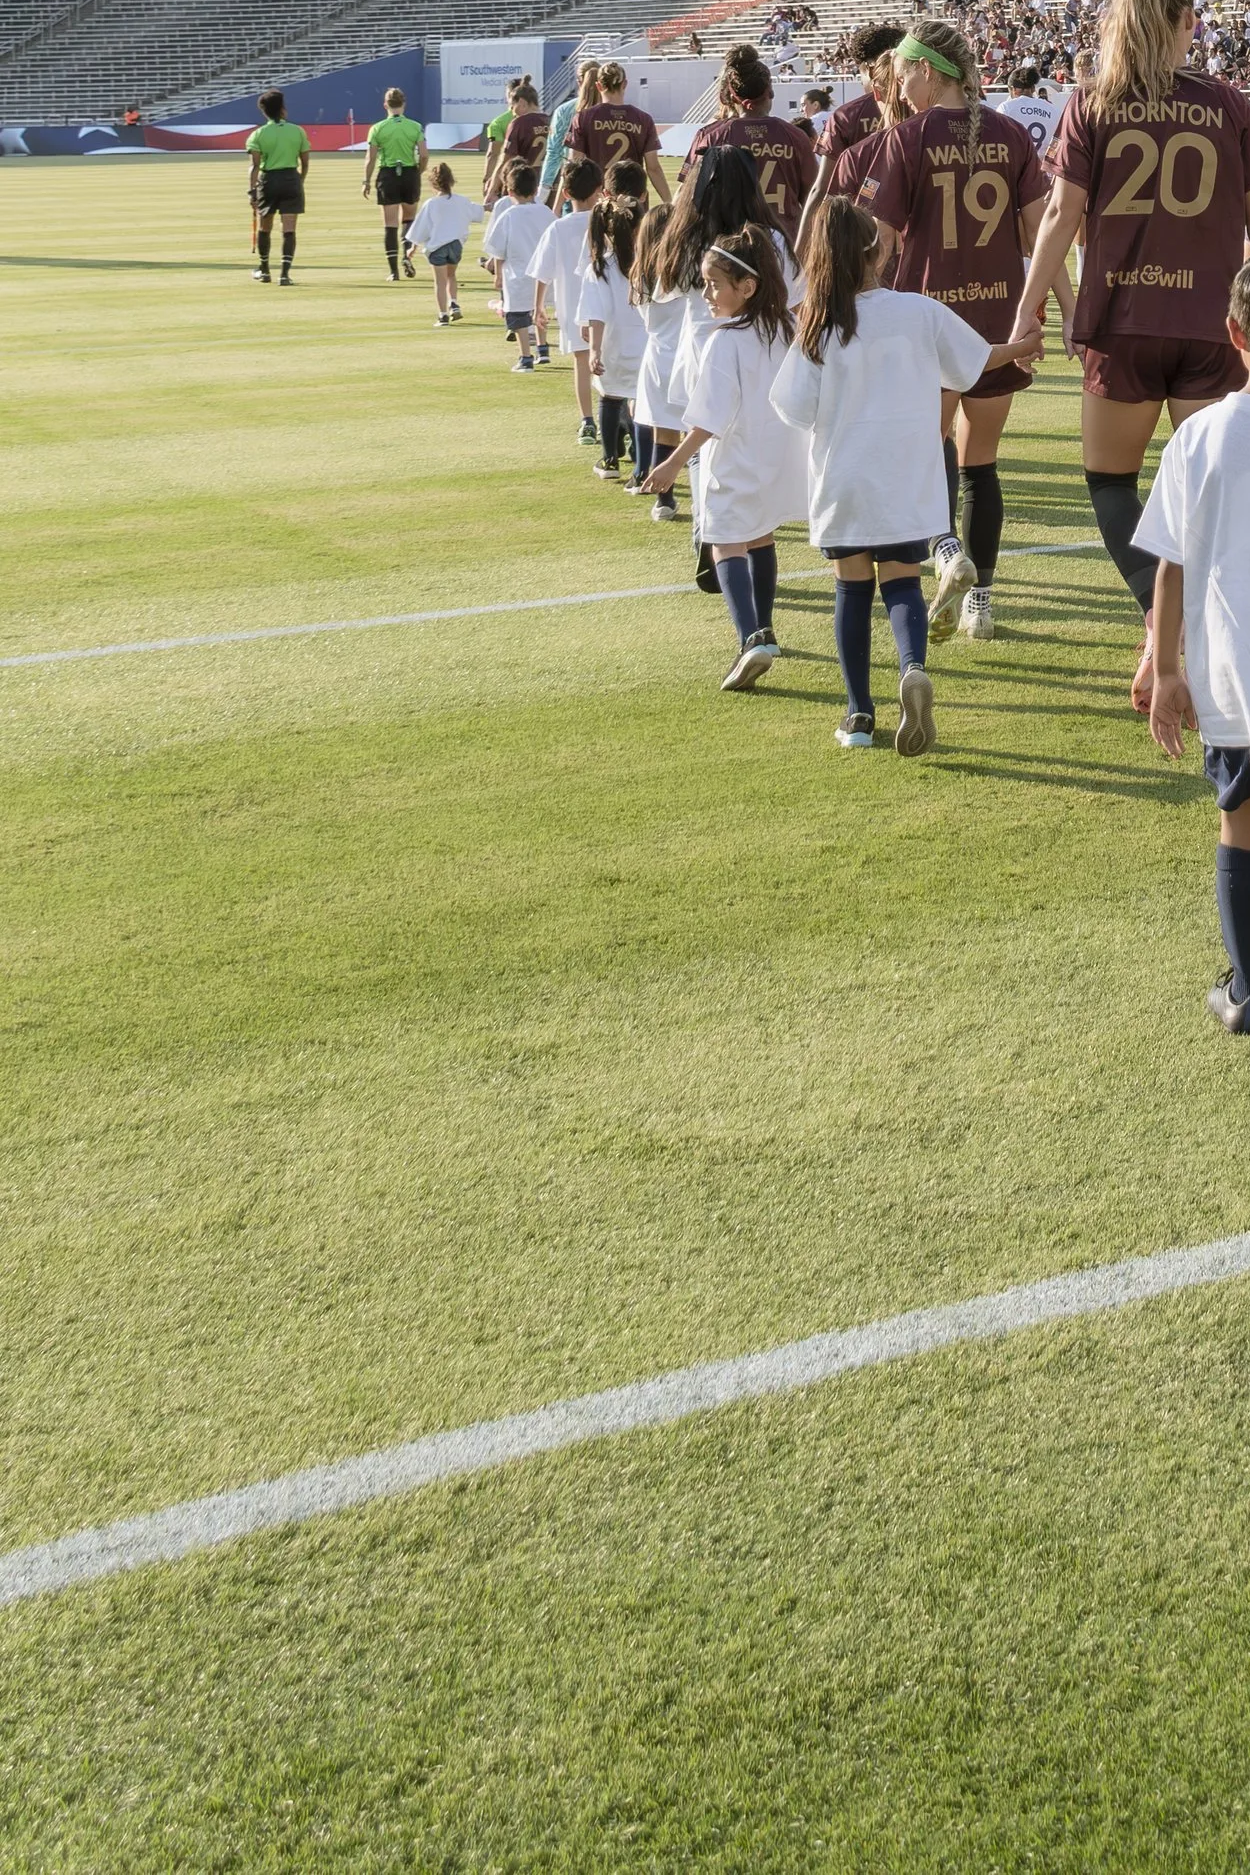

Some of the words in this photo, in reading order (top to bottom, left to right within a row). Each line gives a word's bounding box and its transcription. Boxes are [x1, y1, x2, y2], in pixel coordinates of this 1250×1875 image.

[1020, 106, 1051, 119] CORBIN
[1104, 100, 1223, 129] THORNTON
[533, 125, 551, 135] BRO
[594, 120, 642, 134] DAVISON
[1028, 122, 1046, 150] 9
[532, 136, 547, 167] 2
[606, 132, 630, 169] 2
[741, 143, 794, 160] GAGU
[759, 160, 787, 214] 4
[1100, 129, 1218, 217] 20
[931, 170, 1010, 250] 19
[1105, 264, 1194, 289] trust&will
